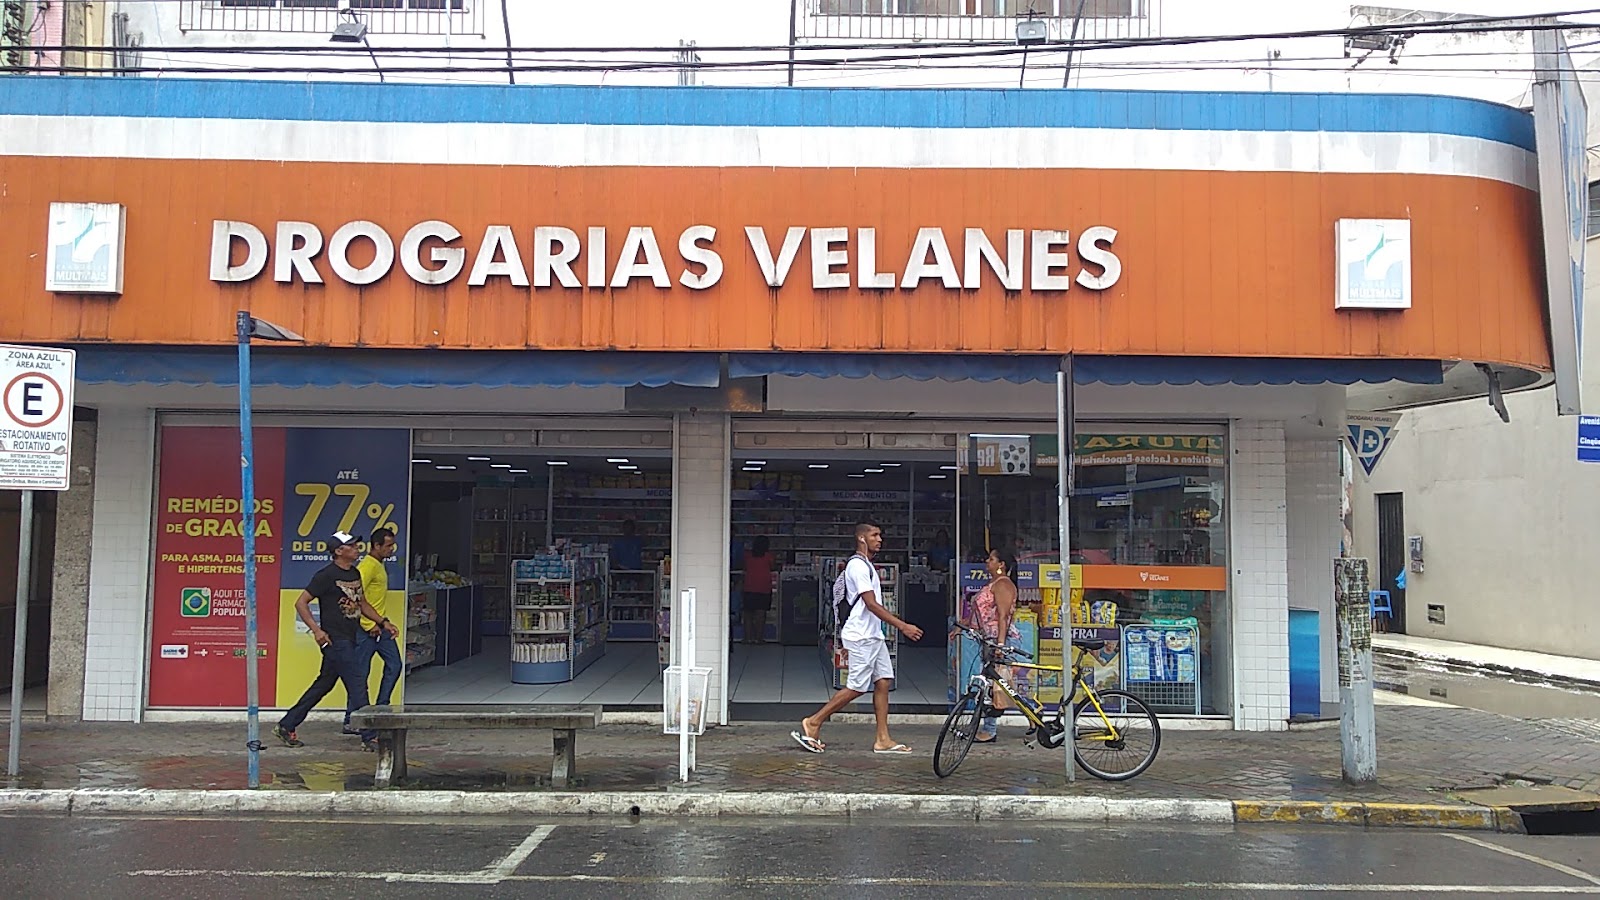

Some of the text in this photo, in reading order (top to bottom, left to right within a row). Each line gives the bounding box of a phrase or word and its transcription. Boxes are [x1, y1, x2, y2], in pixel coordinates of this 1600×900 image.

[209, 219, 1122, 292] DROGARIAS VELANES
[8, 351, 61, 362] ZONA AZUL
[16, 360, 53, 370] ÁREA AZUL
[23, 382, 43, 415] E
[13, 440, 51, 451] ROTATIVO
[337, 468, 359, 480] ATÉ
[295, 483, 399, 537] 77%
[166, 523, 183, 533] DE
[292, 541, 313, 552] DE
[161, 554, 275, 563] PARA ASMA, DIATES
[178, 565, 257, 574] E HIPERTENS
[213, 589, 247, 598] AQUI TE
[1053, 627, 1098, 639] BFRA
